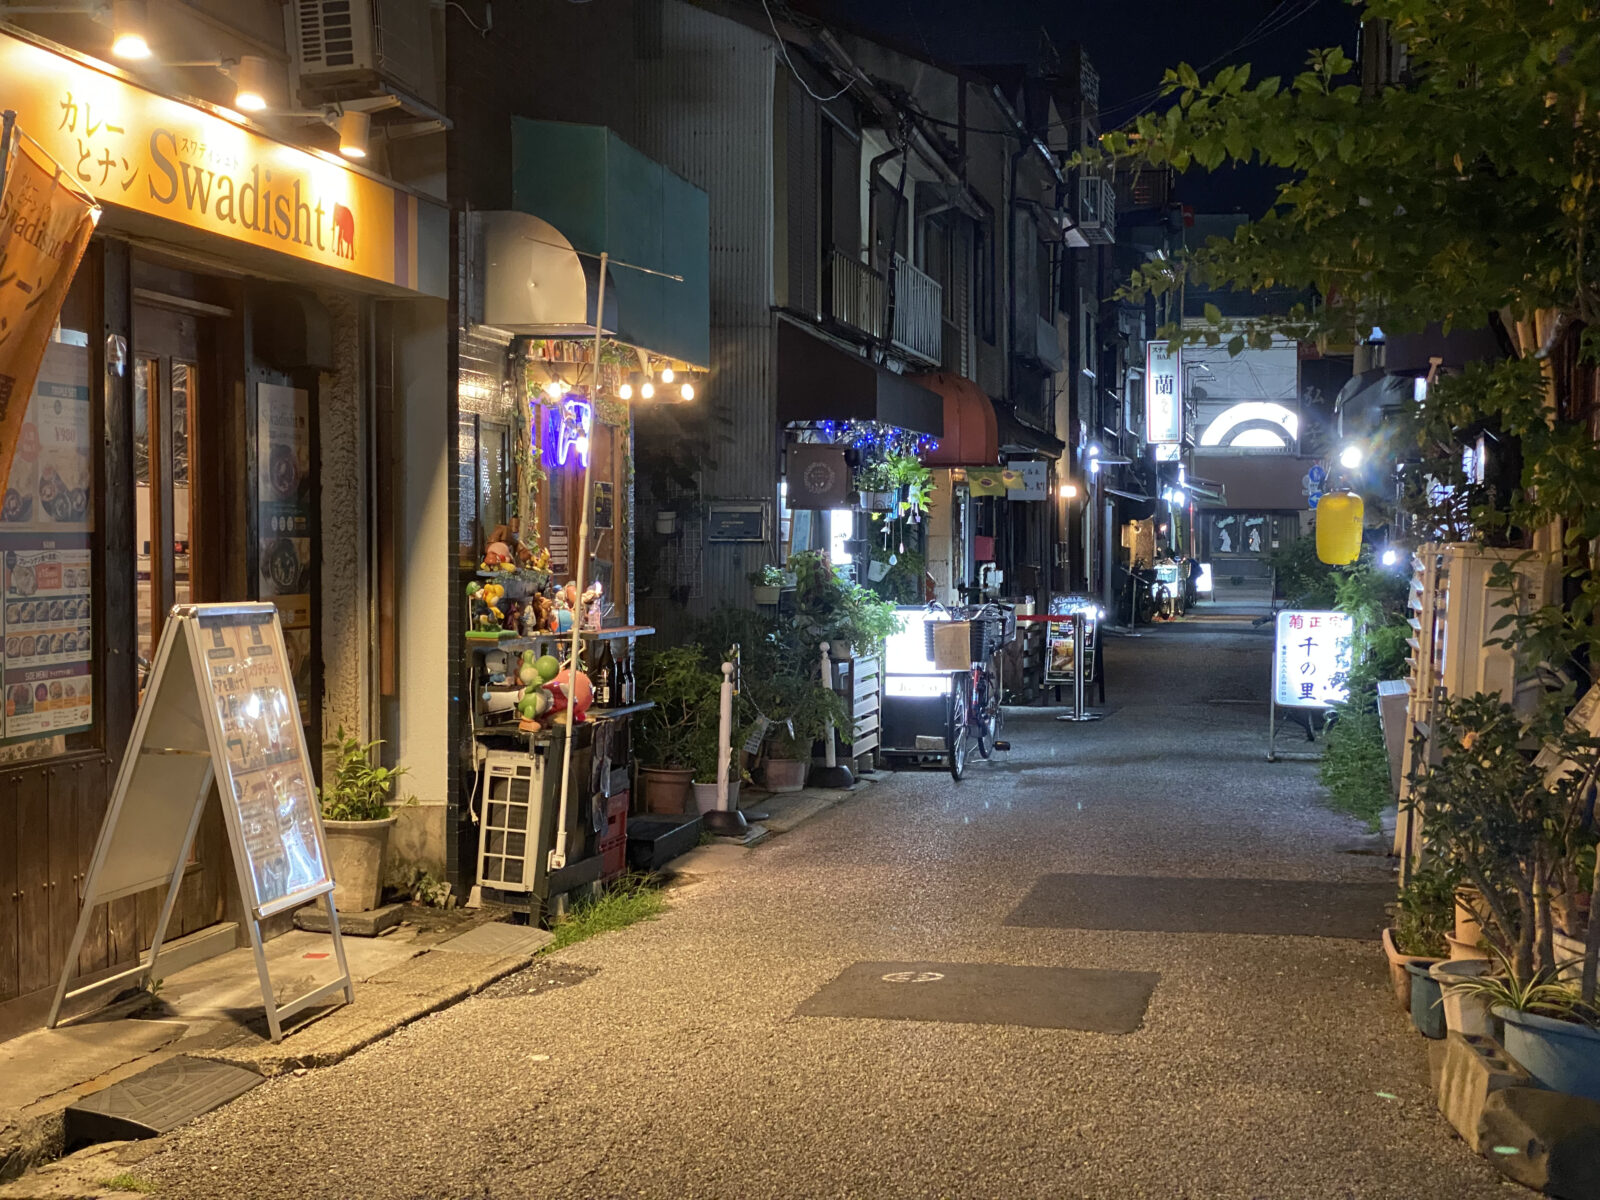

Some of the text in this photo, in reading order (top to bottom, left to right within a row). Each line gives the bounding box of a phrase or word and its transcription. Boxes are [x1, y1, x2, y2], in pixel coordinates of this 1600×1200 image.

[59, 91, 125, 138] カレー
[77, 138, 140, 192] とナン
[148, 127, 326, 251] Swadisht
[1298, 636, 1319, 701] 千の里
